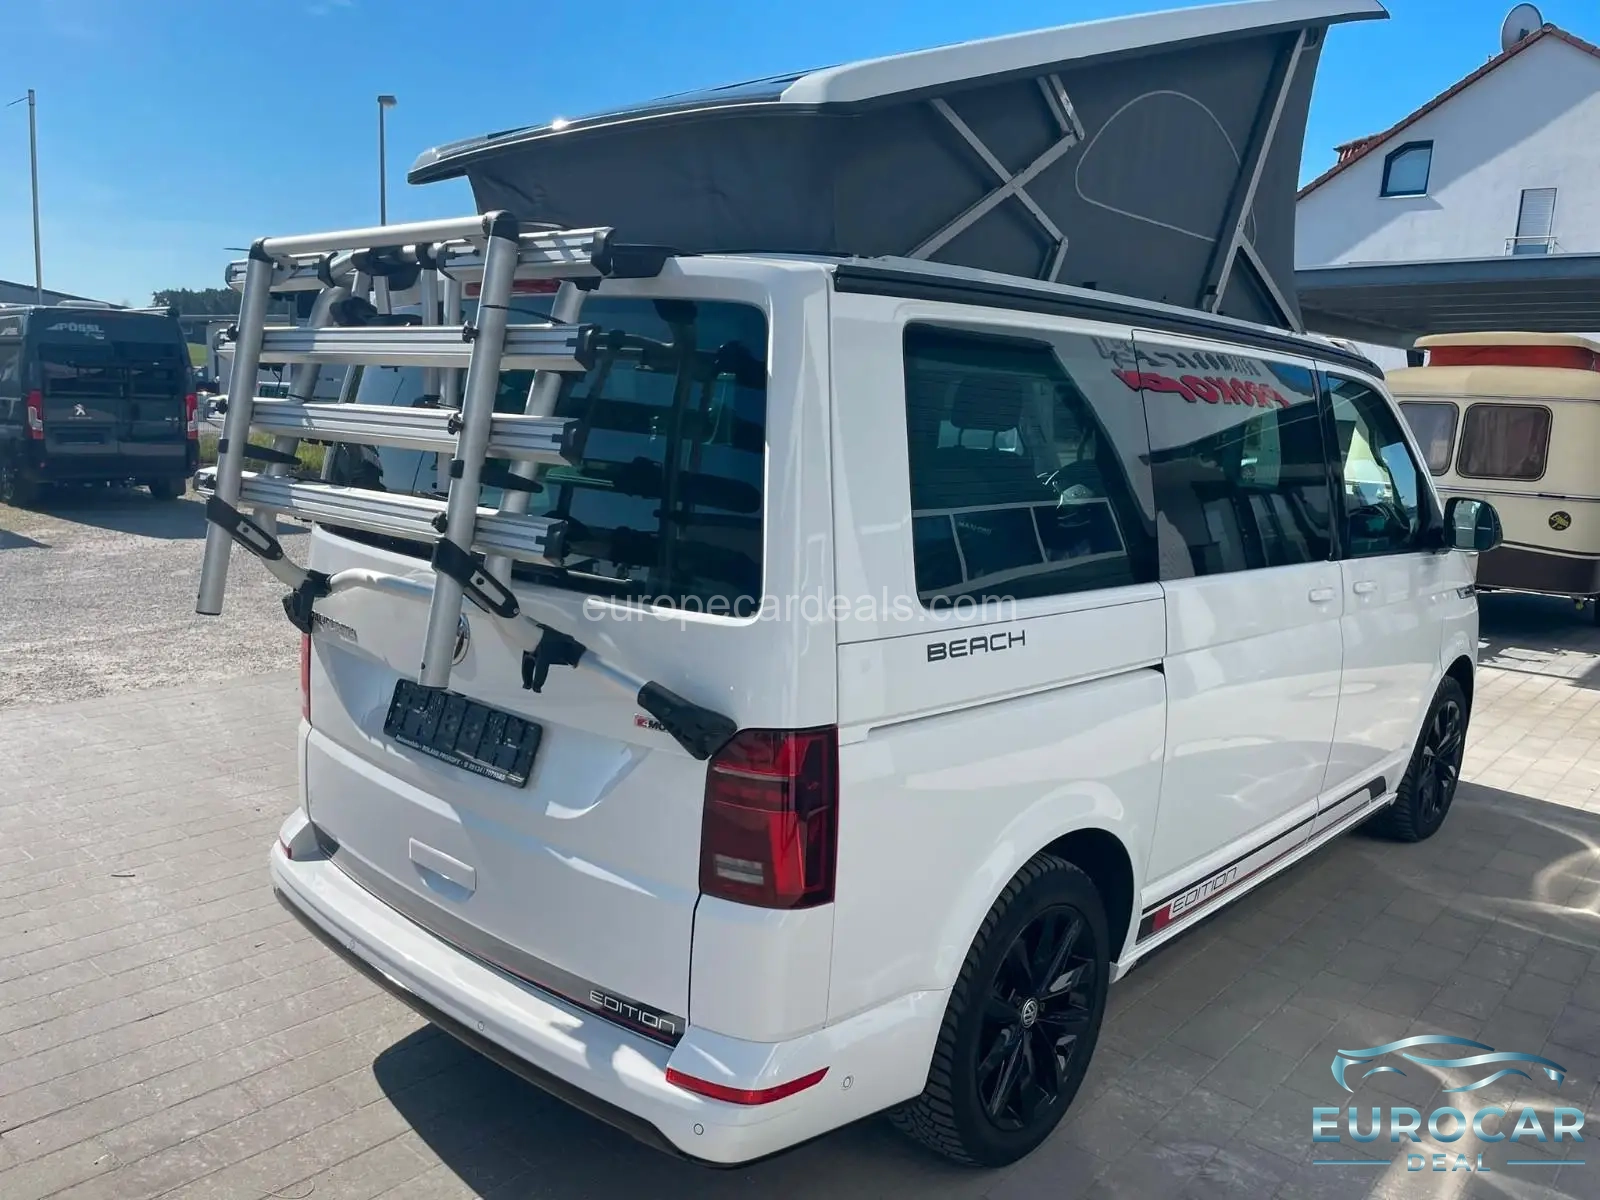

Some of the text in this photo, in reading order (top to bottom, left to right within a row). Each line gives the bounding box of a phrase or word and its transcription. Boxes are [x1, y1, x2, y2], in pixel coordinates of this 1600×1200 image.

[927, 629, 1026, 663] BEACH
[1172, 866, 1238, 914] EDITION
[589, 990, 675, 1035] EDITION
